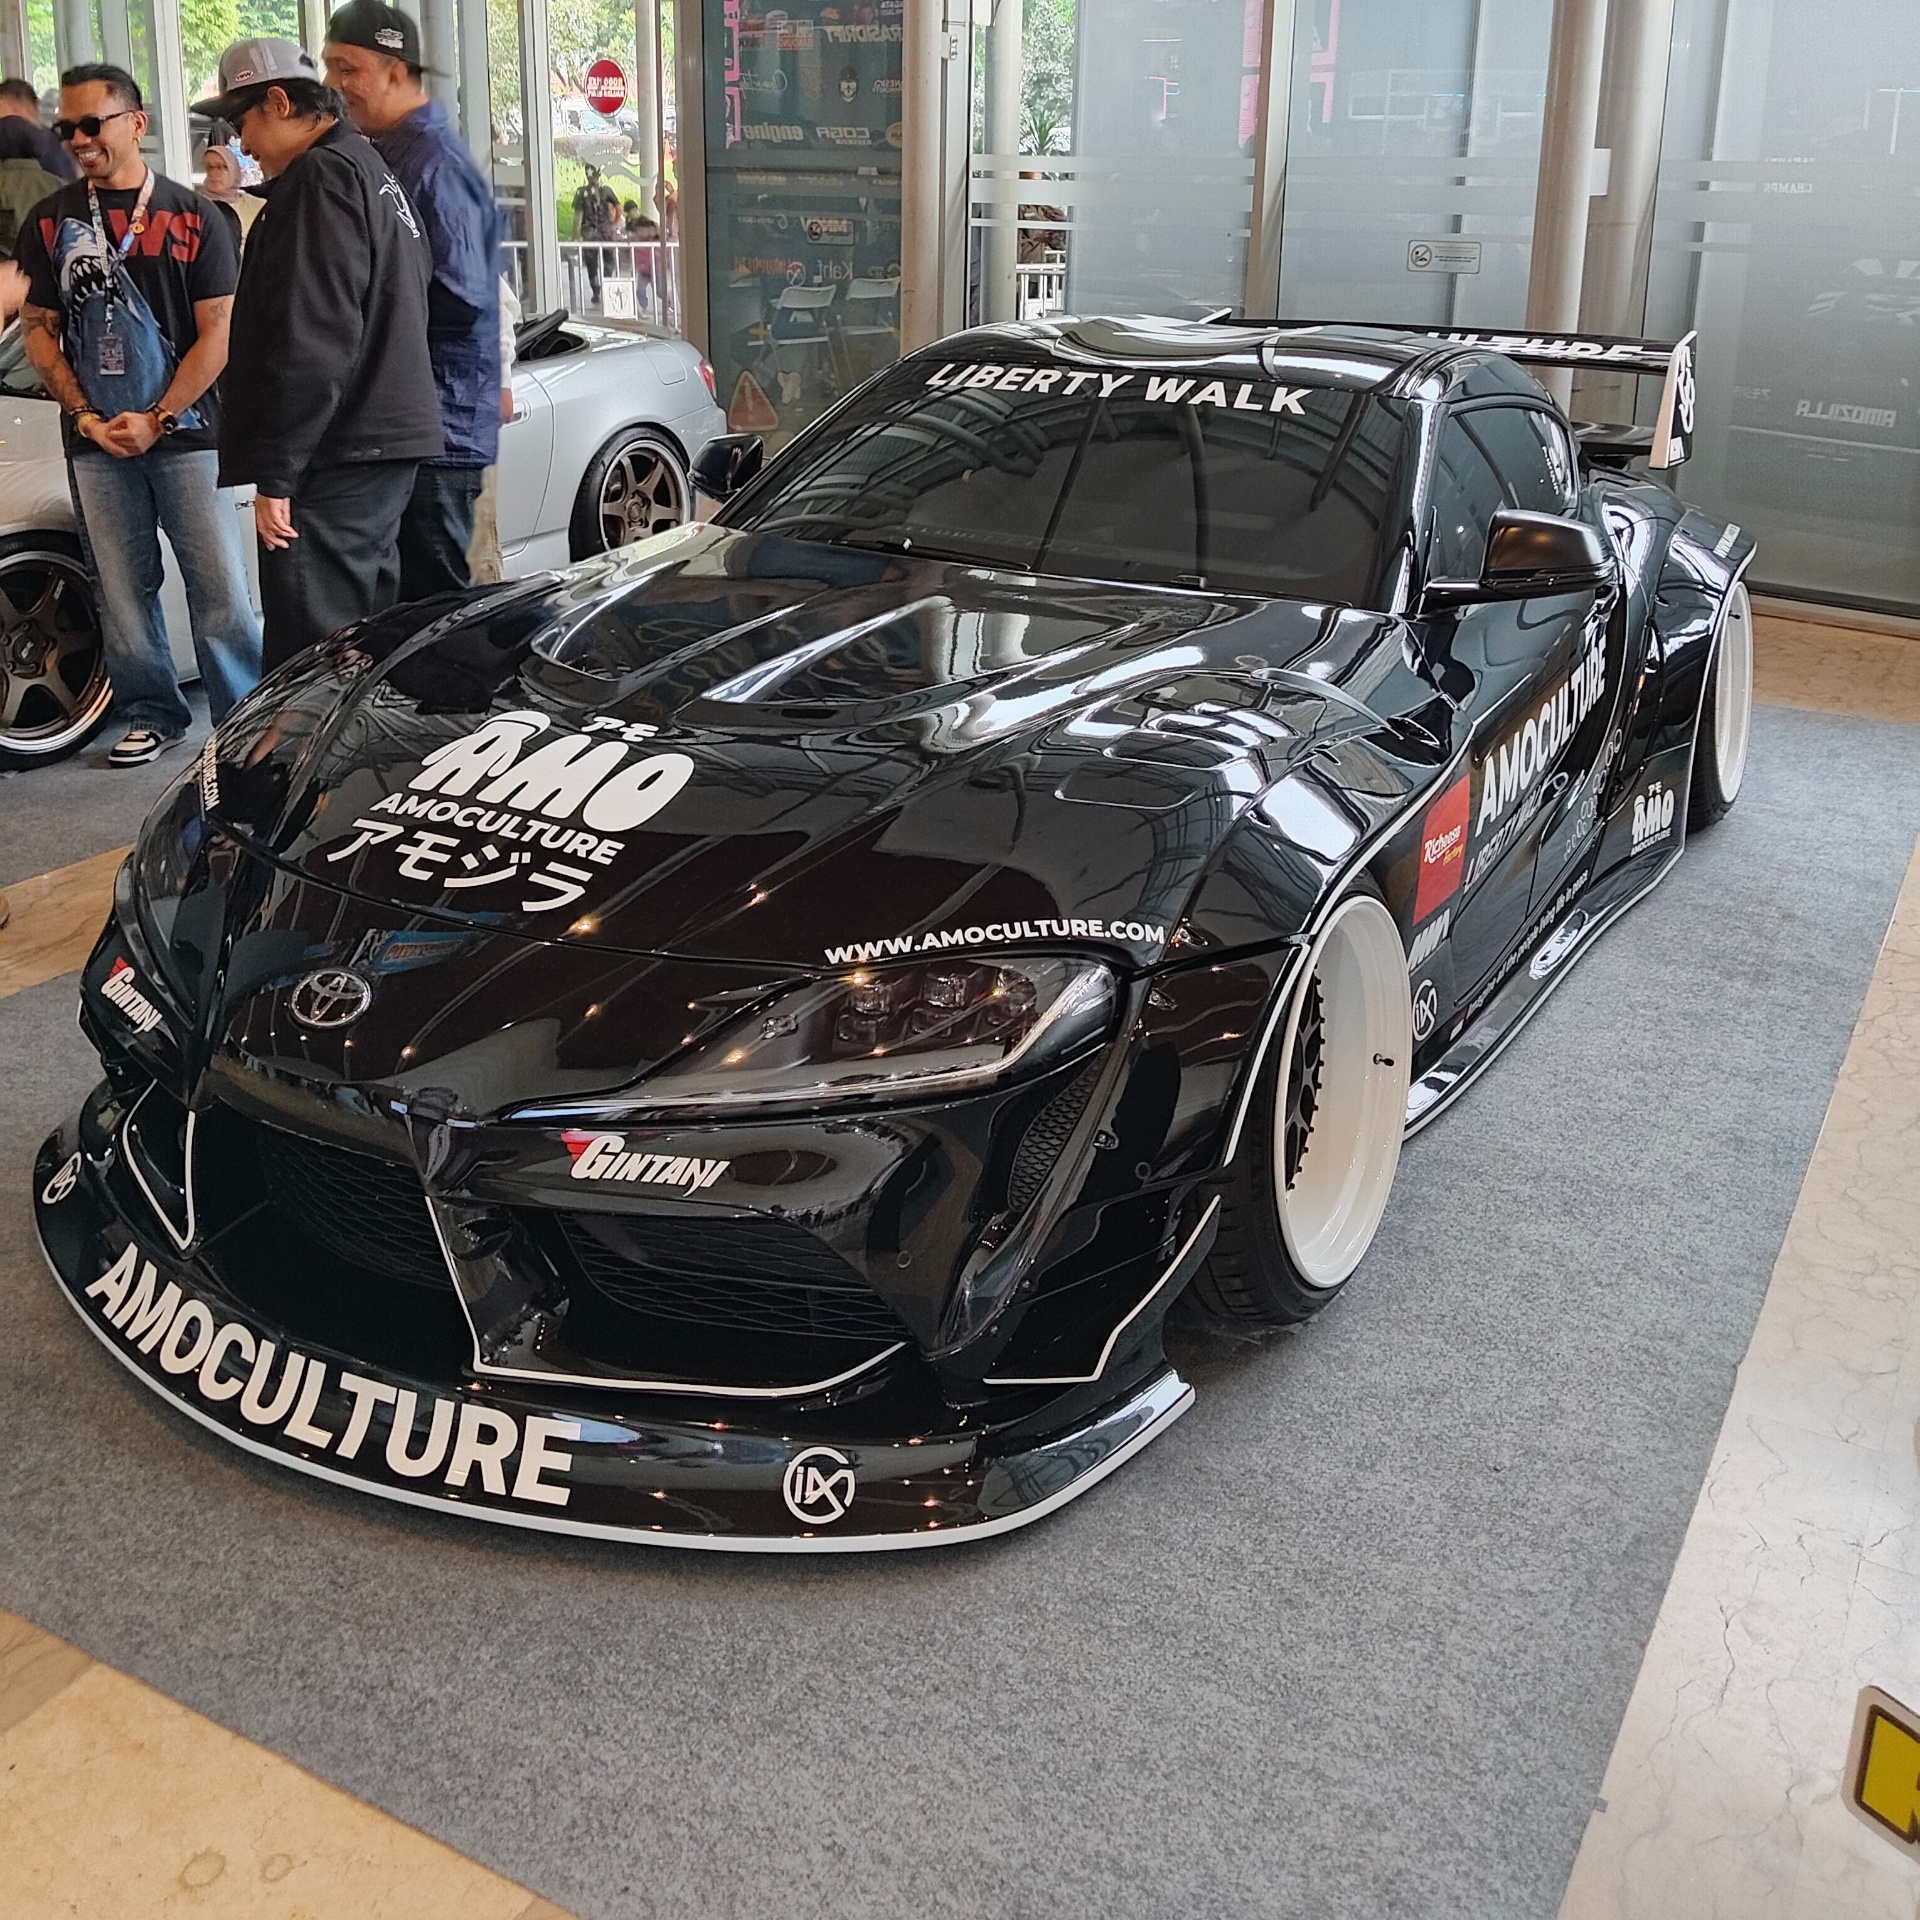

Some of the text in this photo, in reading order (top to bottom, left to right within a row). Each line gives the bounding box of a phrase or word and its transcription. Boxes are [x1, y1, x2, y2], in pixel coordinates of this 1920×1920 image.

[925, 363, 1314, 415] LIBERTY WALK
[581, 716, 660, 743] アモ
[1475, 643, 1607, 838] AMOCULTURE
[408, 710, 695, 832] AMO
[369, 792, 626, 866] AMOCULTURE
[1630, 827, 1672, 857] AMOCULTURE
[1631, 788, 1675, 845] AMO
[326, 817, 594, 912] アモジラ
[824, 918, 1166, 965] WWW.AMOCULTURE.COM
[85, 1241, 582, 1506] AMOCULTURE
